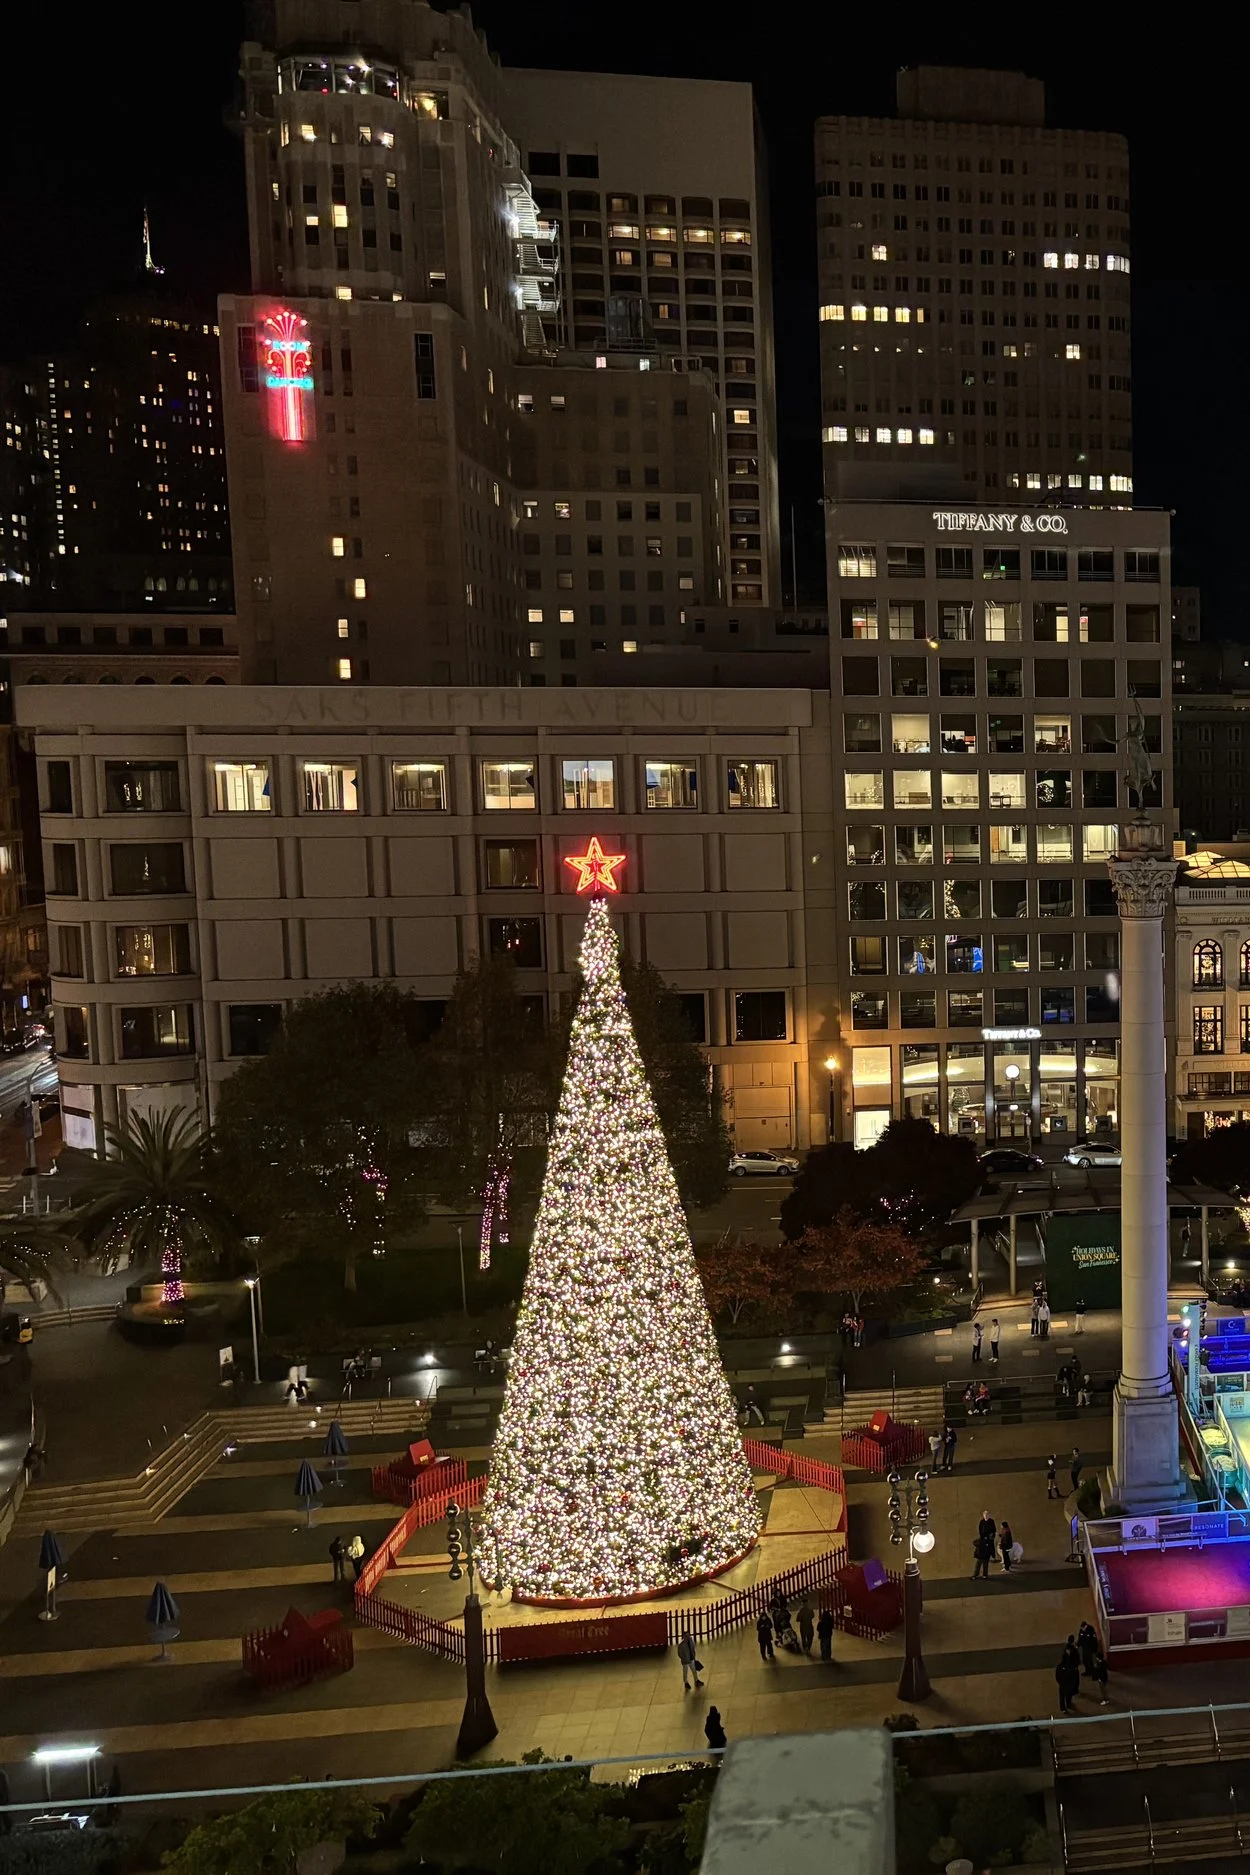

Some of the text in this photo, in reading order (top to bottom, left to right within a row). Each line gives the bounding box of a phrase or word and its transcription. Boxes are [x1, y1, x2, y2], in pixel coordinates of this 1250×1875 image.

[933, 512, 1068, 534] TIFFANY & CO.
[257, 690, 732, 722] SAKS FIFTH AVENUE
[1076, 1246, 1106, 1255] HOLIDAYS
[1073, 1252, 1118, 1261] UNION SQUARE
[1194, 1523, 1225, 1531] RESONATE
[587, 1625, 610, 1637] Tree
